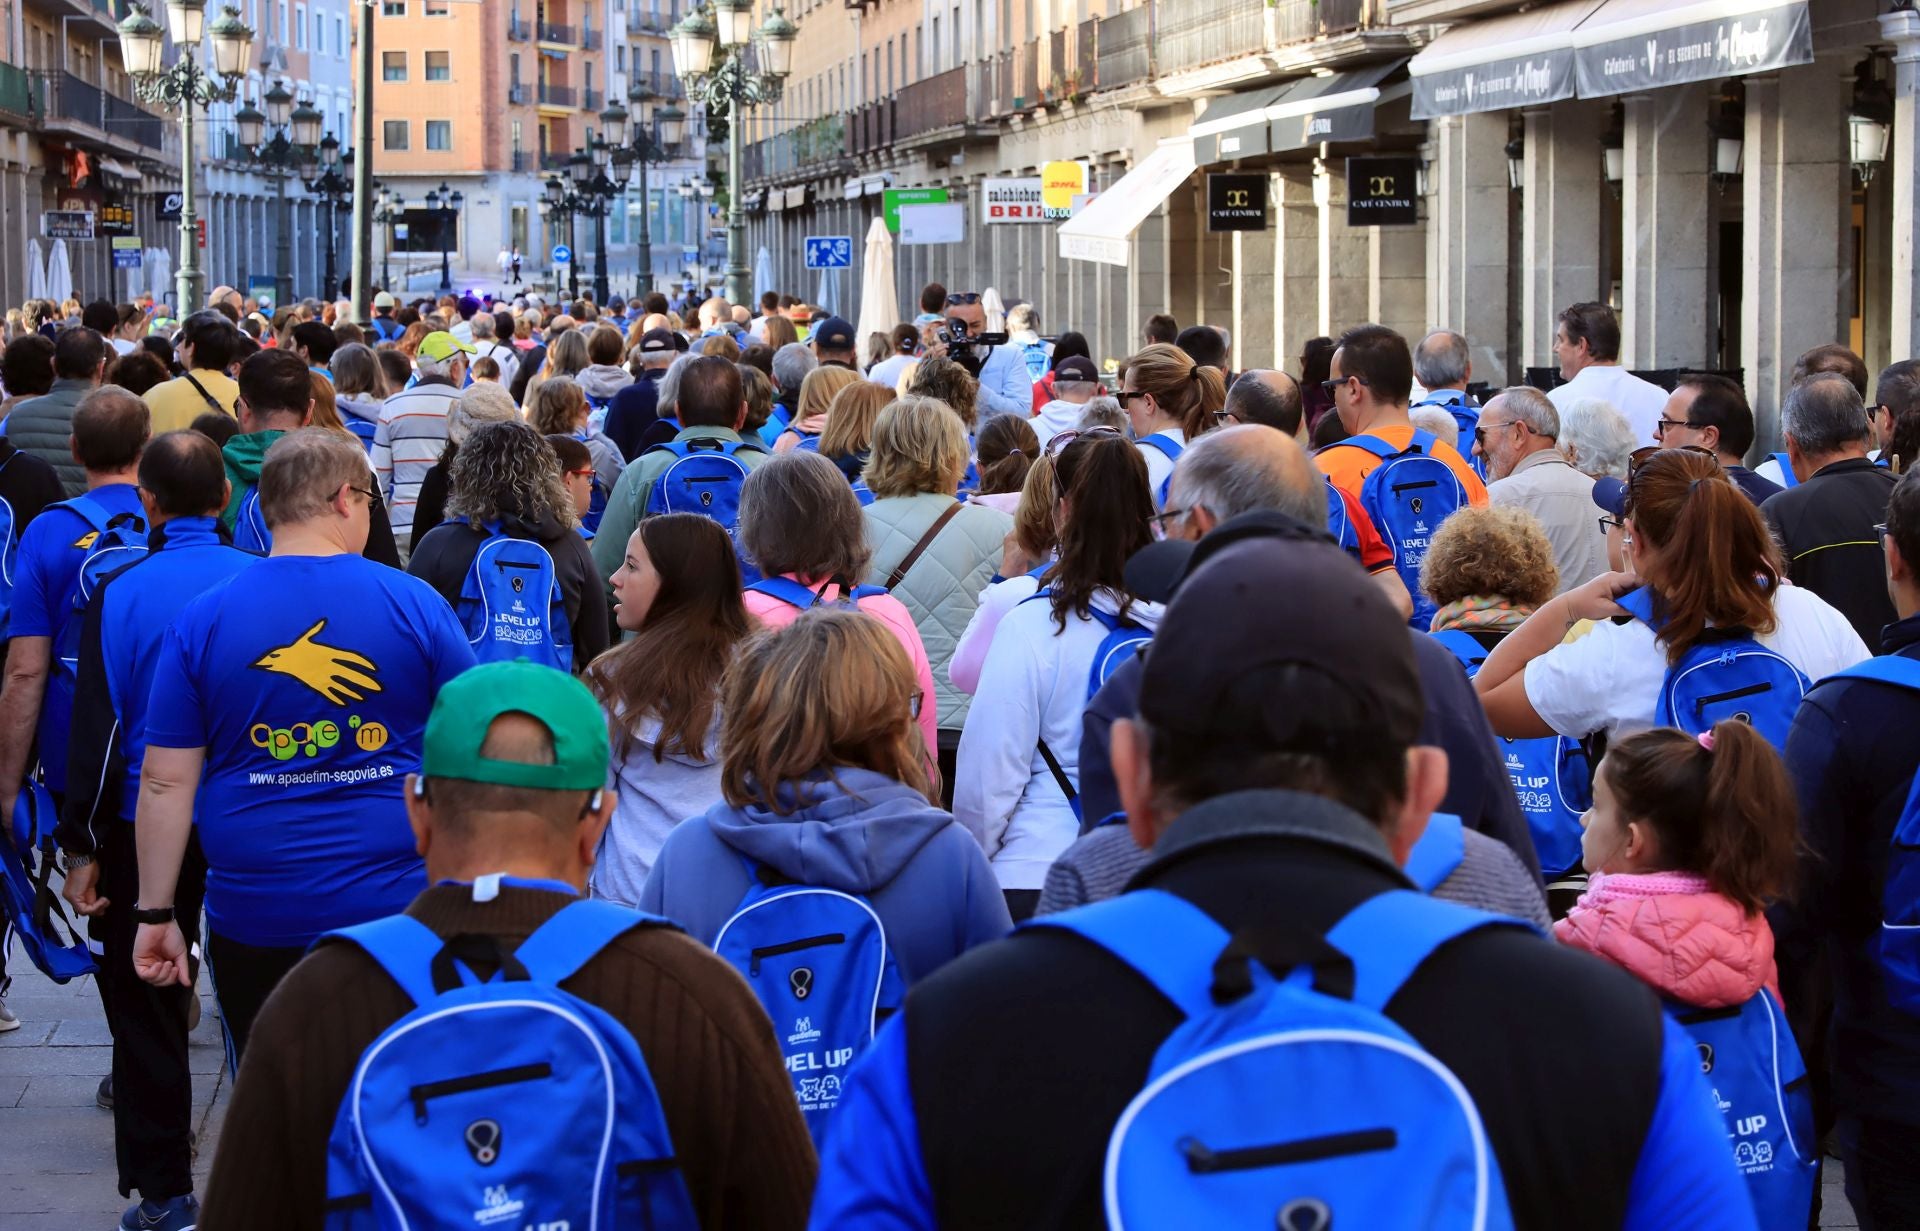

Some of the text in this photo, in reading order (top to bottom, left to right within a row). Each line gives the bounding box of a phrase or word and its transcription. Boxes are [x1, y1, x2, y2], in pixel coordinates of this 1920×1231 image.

[1668, 49, 1676, 64] EL
[1677, 43, 1701, 62] SECRETO
[1703, 41, 1712, 58] DE
[1375, 199, 1412, 208] CENTRAL
[1044, 208, 1072, 218] 10:00
[495, 613, 541, 627] LEVEL UP
[249, 764, 394, 788] www.apadefim-segovia.es
[1527, 776, 1549, 788] UP
[825, 1047, 853, 1068] UP
[1736, 1114, 1767, 1136] UP
